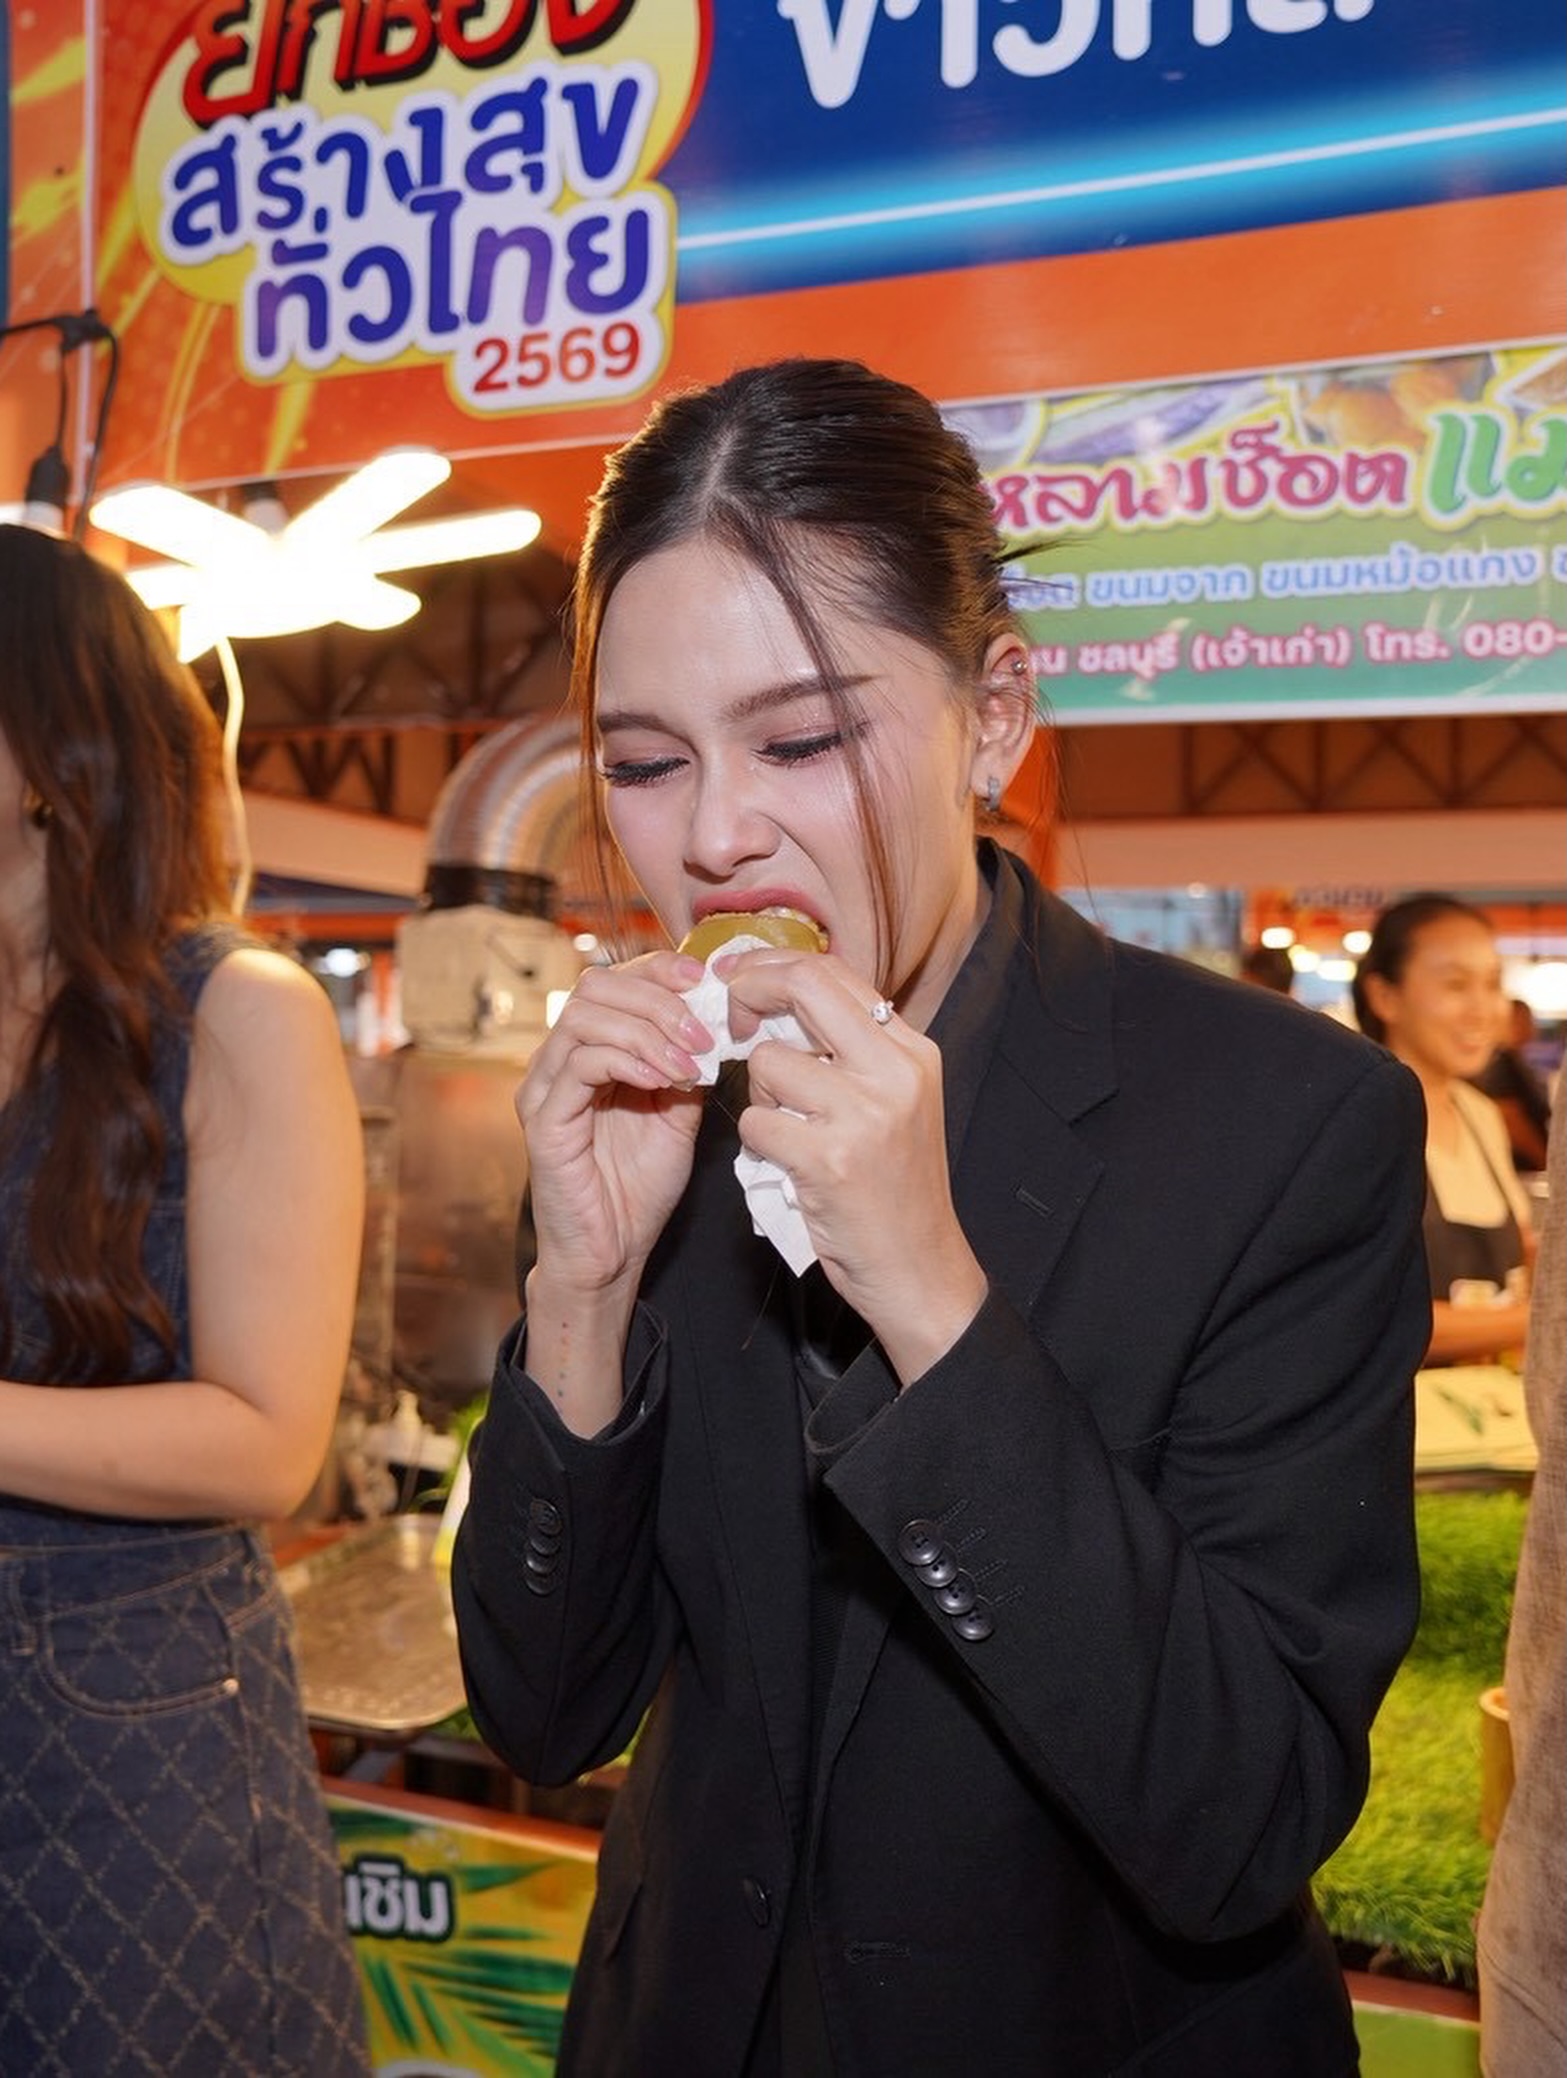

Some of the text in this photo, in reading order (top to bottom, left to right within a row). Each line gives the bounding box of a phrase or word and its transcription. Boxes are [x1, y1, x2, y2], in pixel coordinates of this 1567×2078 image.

[171, 77, 640, 246] สร้างสุข
[256, 190, 650, 359] ทั่วไทย
[471, 321, 641, 394] 2569
[1266, 546, 1537, 592] ขนมหม้อแกง
[1364, 623, 1450, 661] โทร.
